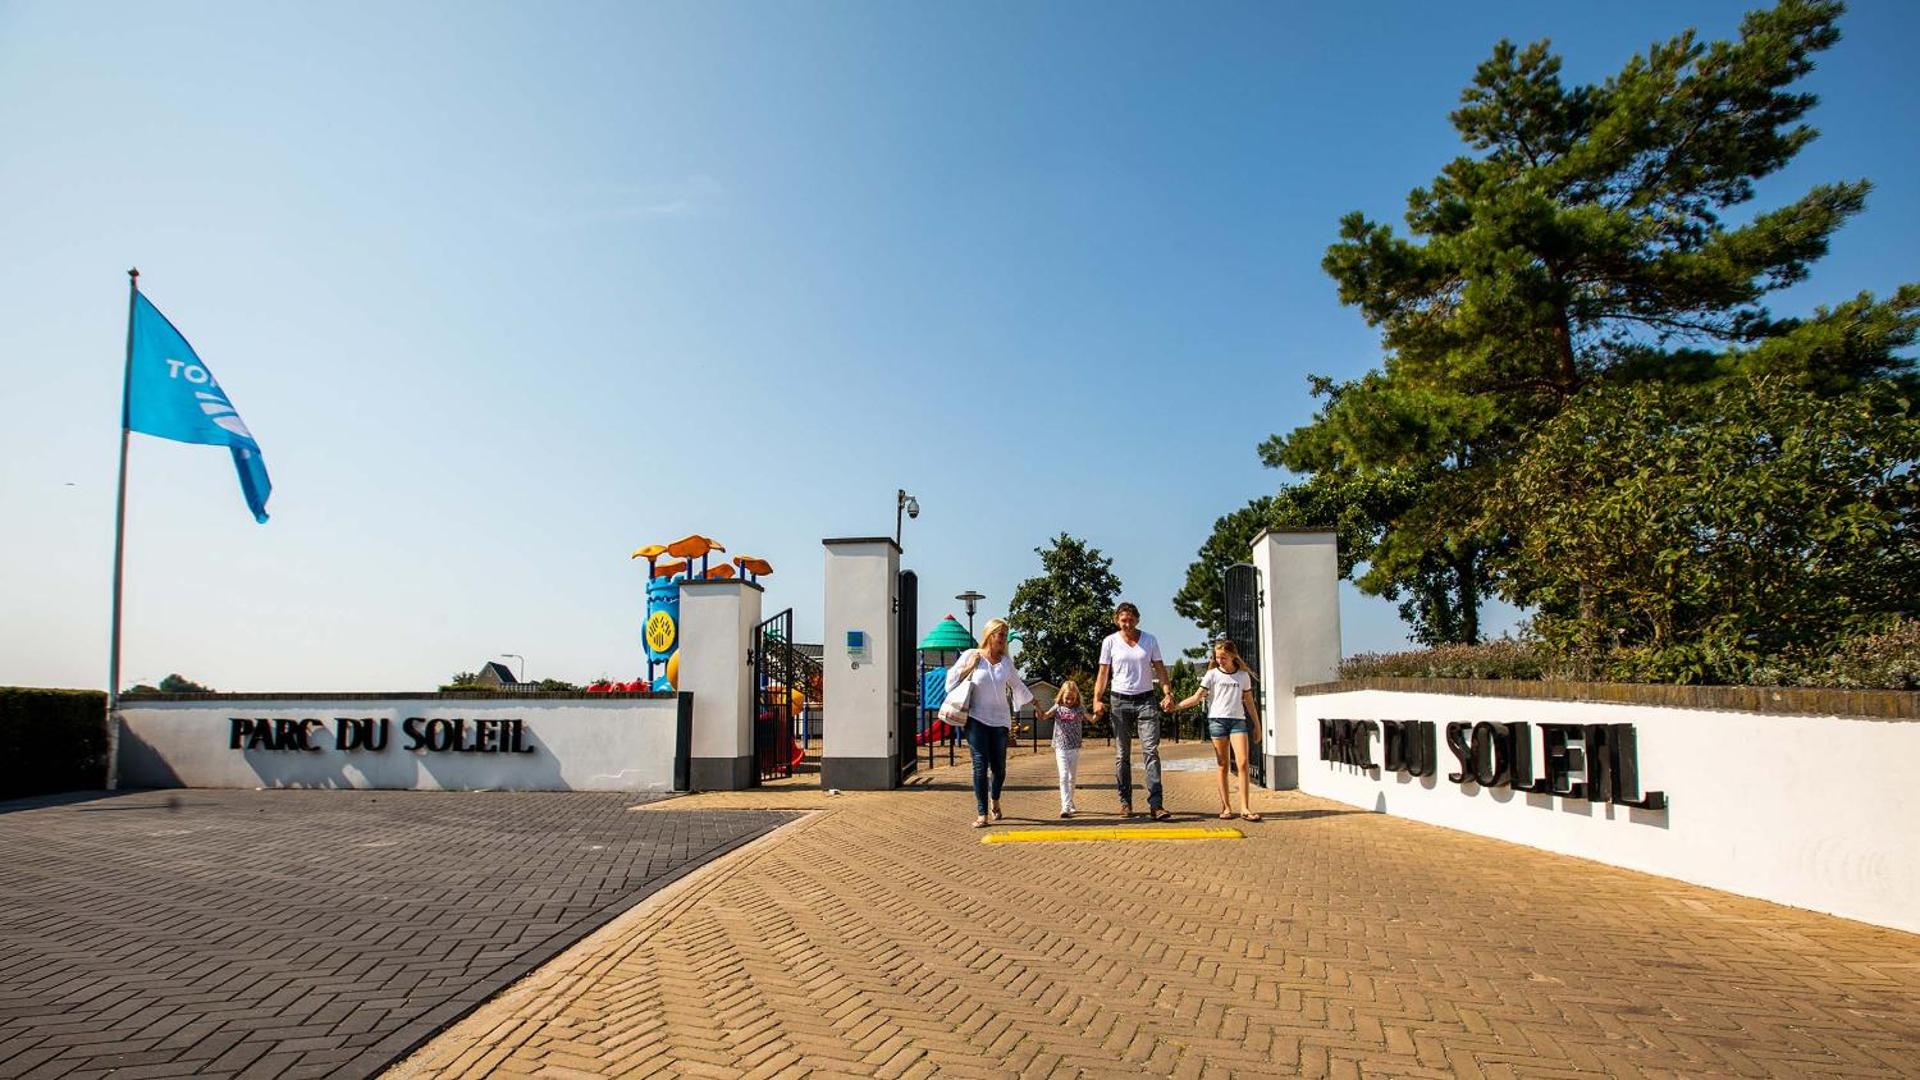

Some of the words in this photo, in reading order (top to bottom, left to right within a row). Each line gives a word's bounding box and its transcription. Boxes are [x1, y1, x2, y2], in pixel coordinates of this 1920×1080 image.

[229, 717, 324, 750] PARC
[334, 717, 390, 752] DU
[402, 717, 534, 753] SOLEIL
[1380, 719, 1437, 777] DU
[1446, 721, 1669, 810] SOLEIL
